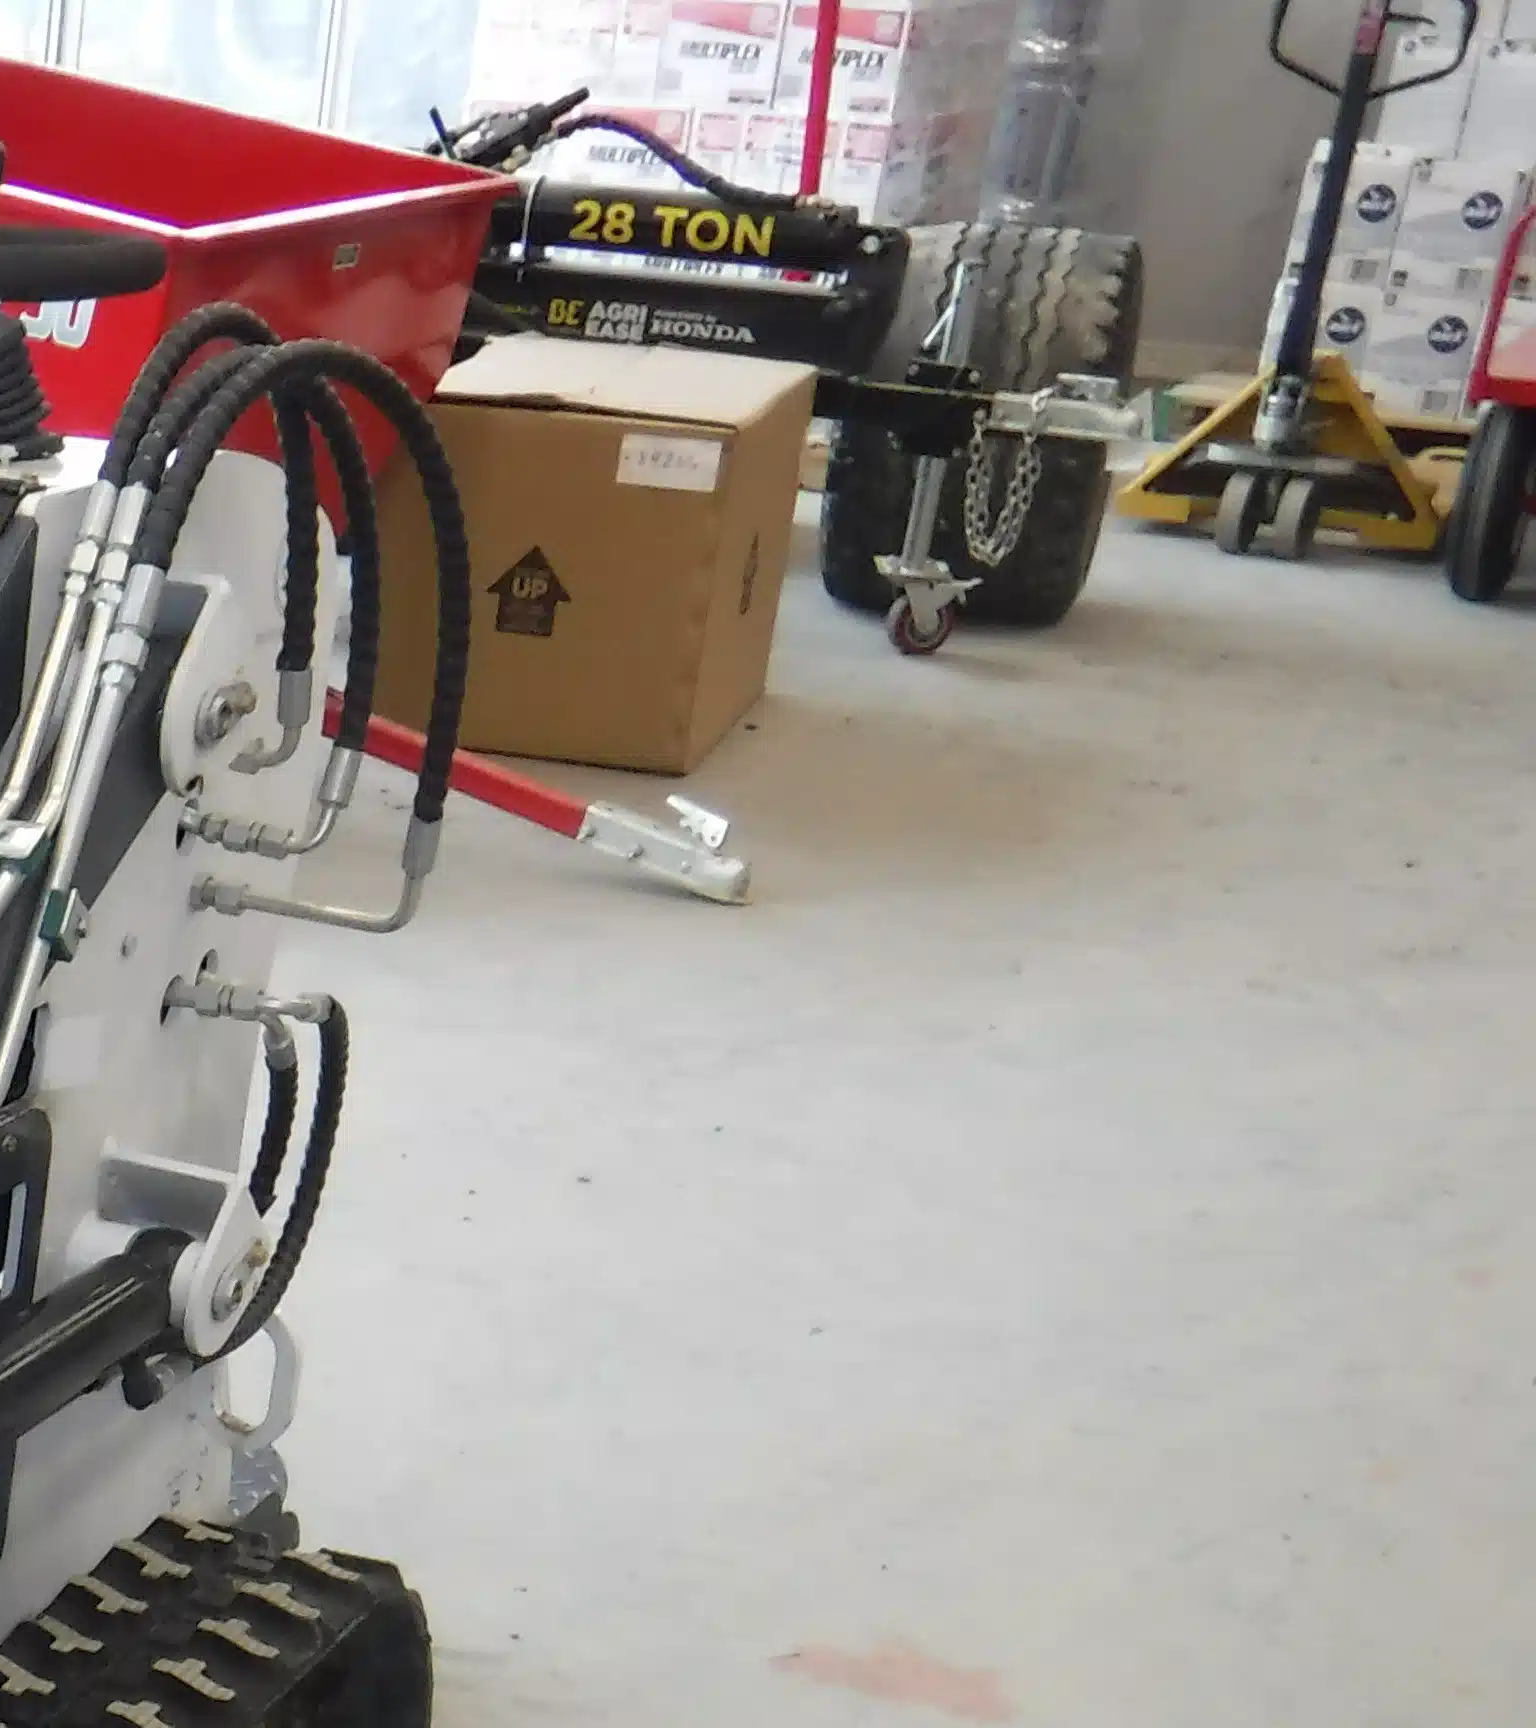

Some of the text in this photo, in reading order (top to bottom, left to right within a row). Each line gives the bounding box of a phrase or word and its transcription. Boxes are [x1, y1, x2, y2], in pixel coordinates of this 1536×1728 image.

[678, 38, 764, 63] MULTIPLEX
[798, 46, 888, 71] MTIPLEX
[568, 198, 776, 258] 28 TON
[587, 299, 649, 324] AGRI
[584, 318, 645, 343] EASE
[648, 318, 757, 345] HONDA
[511, 575, 550, 600] UP
